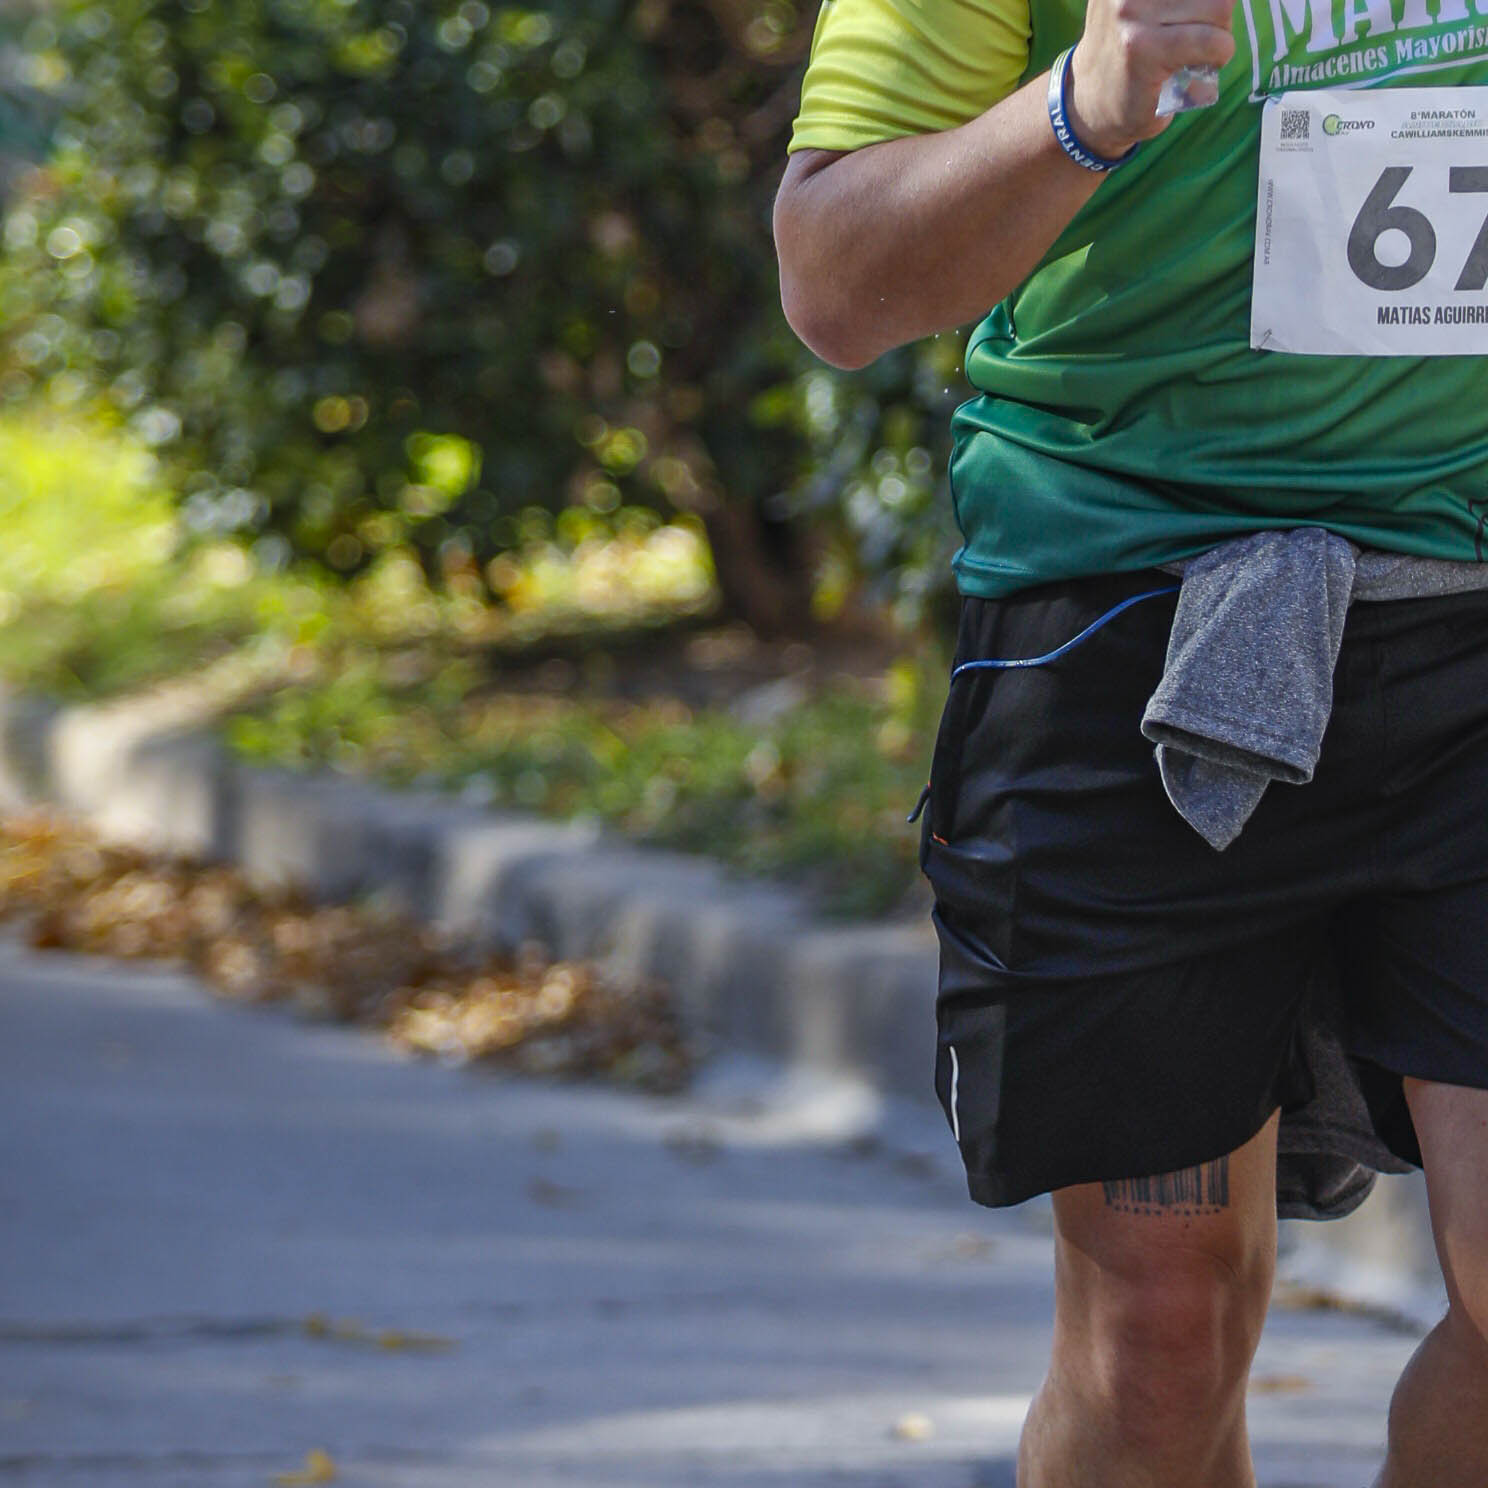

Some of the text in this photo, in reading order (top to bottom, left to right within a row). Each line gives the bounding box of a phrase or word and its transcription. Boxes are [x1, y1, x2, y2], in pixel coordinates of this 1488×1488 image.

[1268, 45, 1389, 90] Almacenes
[1050, 103, 1105, 172] CENTRAL
[1377, 306, 1431, 326] MATIAS
